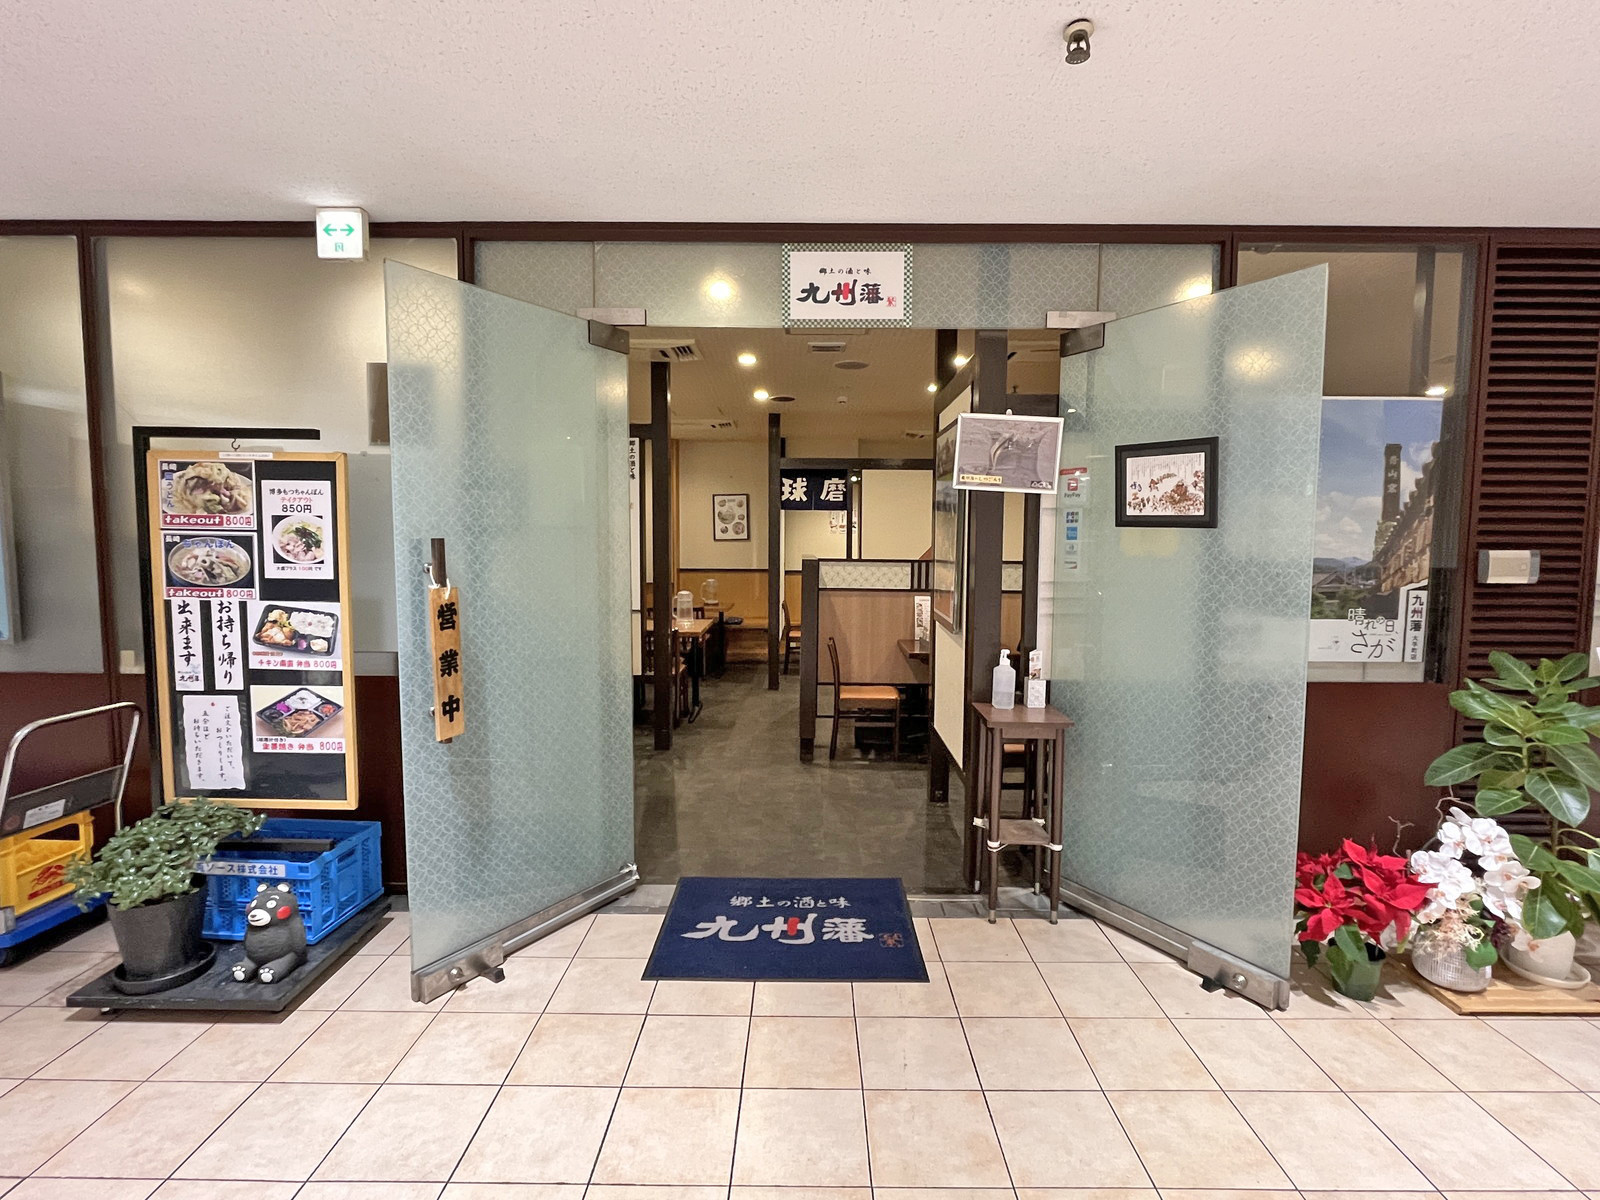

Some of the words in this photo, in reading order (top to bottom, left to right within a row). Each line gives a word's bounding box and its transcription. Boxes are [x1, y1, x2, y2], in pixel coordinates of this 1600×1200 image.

[819, 267, 871, 275] 郷土の酒と味
[796, 279, 884, 306] 九州藩
[781, 477, 846, 502] 球磨
[165, 515, 221, 525] takeout
[281, 504, 312, 513] 850円
[168, 588, 223, 598] takeout
[1410, 595, 1424, 631] 九州藩
[177, 600, 196, 667] 出来ます
[216, 600, 237, 684] お持ち帰り
[1351, 630, 1396, 659] さが
[437, 602, 461, 723] 営業中
[729, 896, 852, 909] 郷土の酒と味
[681, 913, 875, 945] 九州藩
